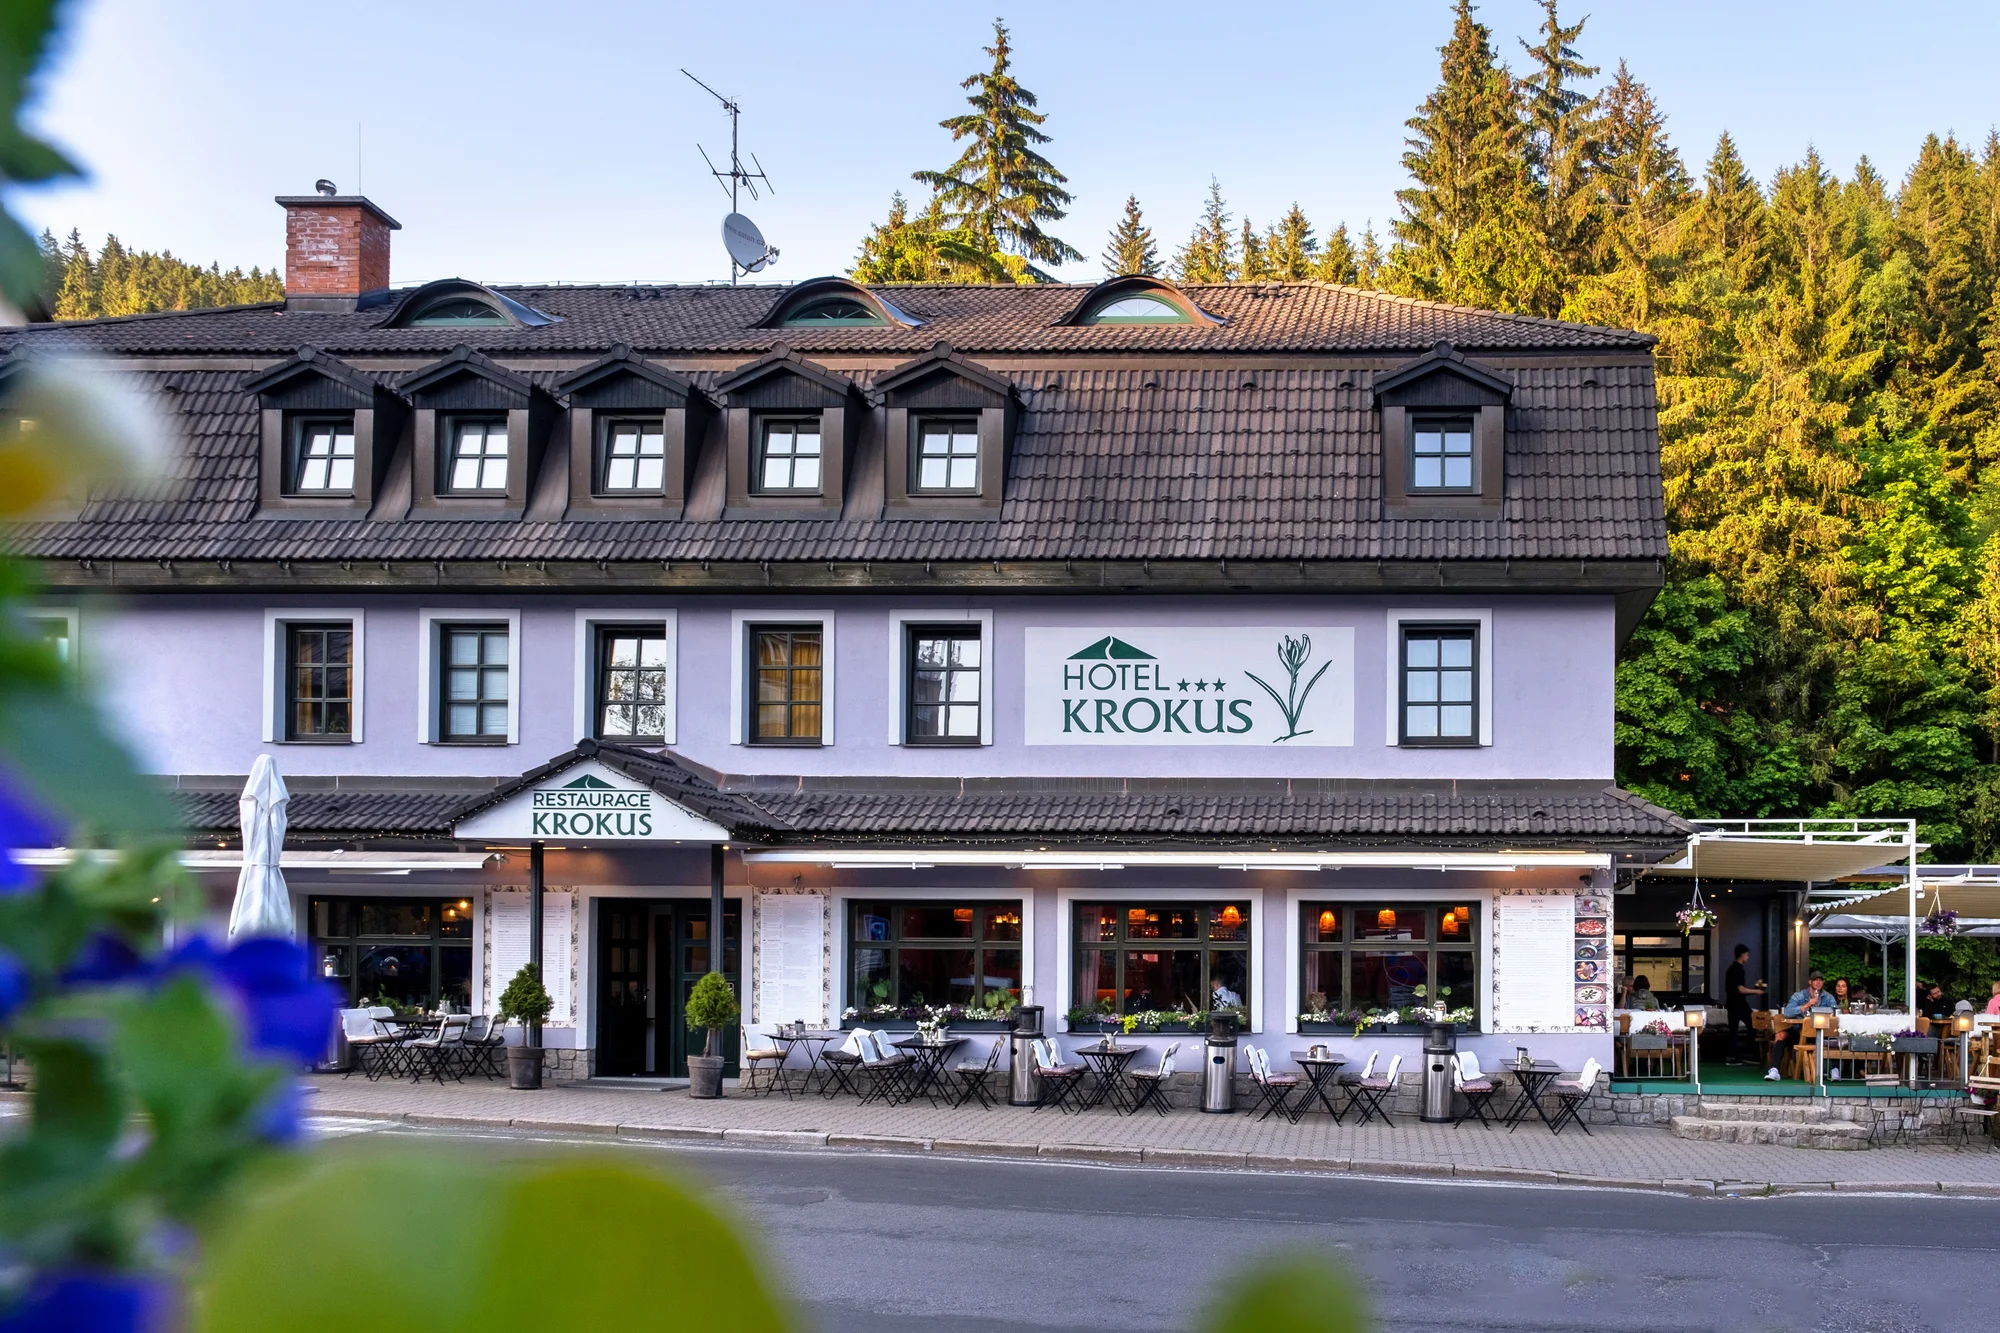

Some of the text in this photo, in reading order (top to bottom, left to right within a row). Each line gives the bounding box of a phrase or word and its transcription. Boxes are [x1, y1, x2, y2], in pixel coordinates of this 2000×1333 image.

[1064, 663, 1170, 690] HOTEL
[1062, 697, 1253, 734] KROKUS
[533, 793, 650, 807] RESTAURACE
[532, 812, 652, 836] KROKUS
